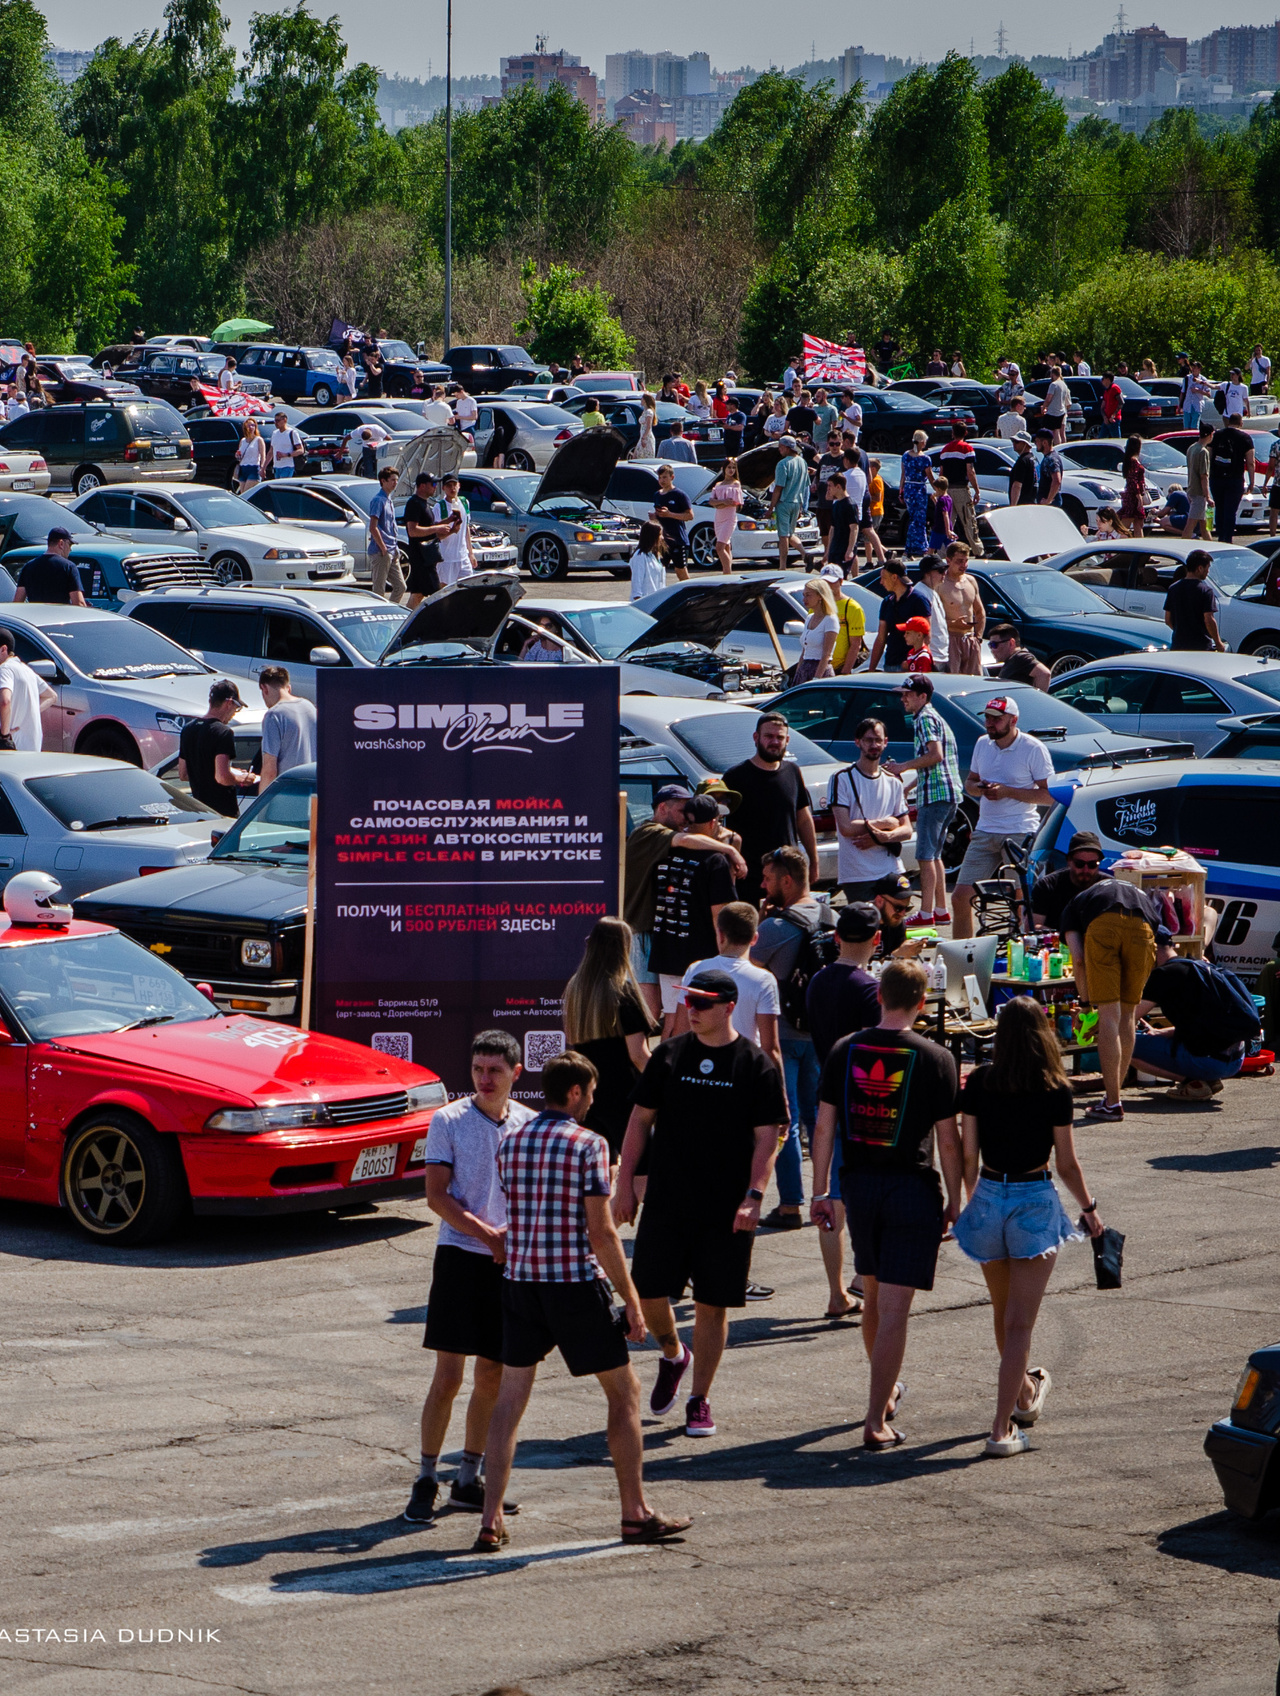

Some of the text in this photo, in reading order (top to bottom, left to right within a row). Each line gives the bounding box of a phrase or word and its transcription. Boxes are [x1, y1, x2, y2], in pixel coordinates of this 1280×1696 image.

[353, 703, 585, 730] SIMPLE
[442, 711, 575, 752] Clean
[353, 738, 426, 752] wash&shop
[373, 797, 564, 812] ПОЧАСОВАЯ МОЙКА
[349, 815, 588, 829] САМООБСЛУЖИВАНИЯ И
[335, 832, 604, 845] МАГАЗИН АВТОКОСМЕТИКИ
[337, 850, 602, 863] SIMPLE CLEAN В ИРКУТСКЕ
[337, 901, 607, 918] ПОЛУЧИ БЕСПЛАТНЫЙ ЧАС МОЙКИ
[390, 917, 556, 933] И 500 РУБЛЕЙ ЗДЕСЬ!
[1239, 956, 1272, 965] RACIN
[378, 999, 418, 1008] Баррикад
[419, 998, 439, 1008] 51/9
[539, 997, 567, 1007] Тракто
[335, 1010, 381, 1019] (арт-завод
[492, 1008, 567, 1018] (рынок «Автосер
[242, 1026, 311, 1049] 403
[507, 1090, 546, 1100] АВТОМО
[360, 1156, 395, 1178] BOOST
